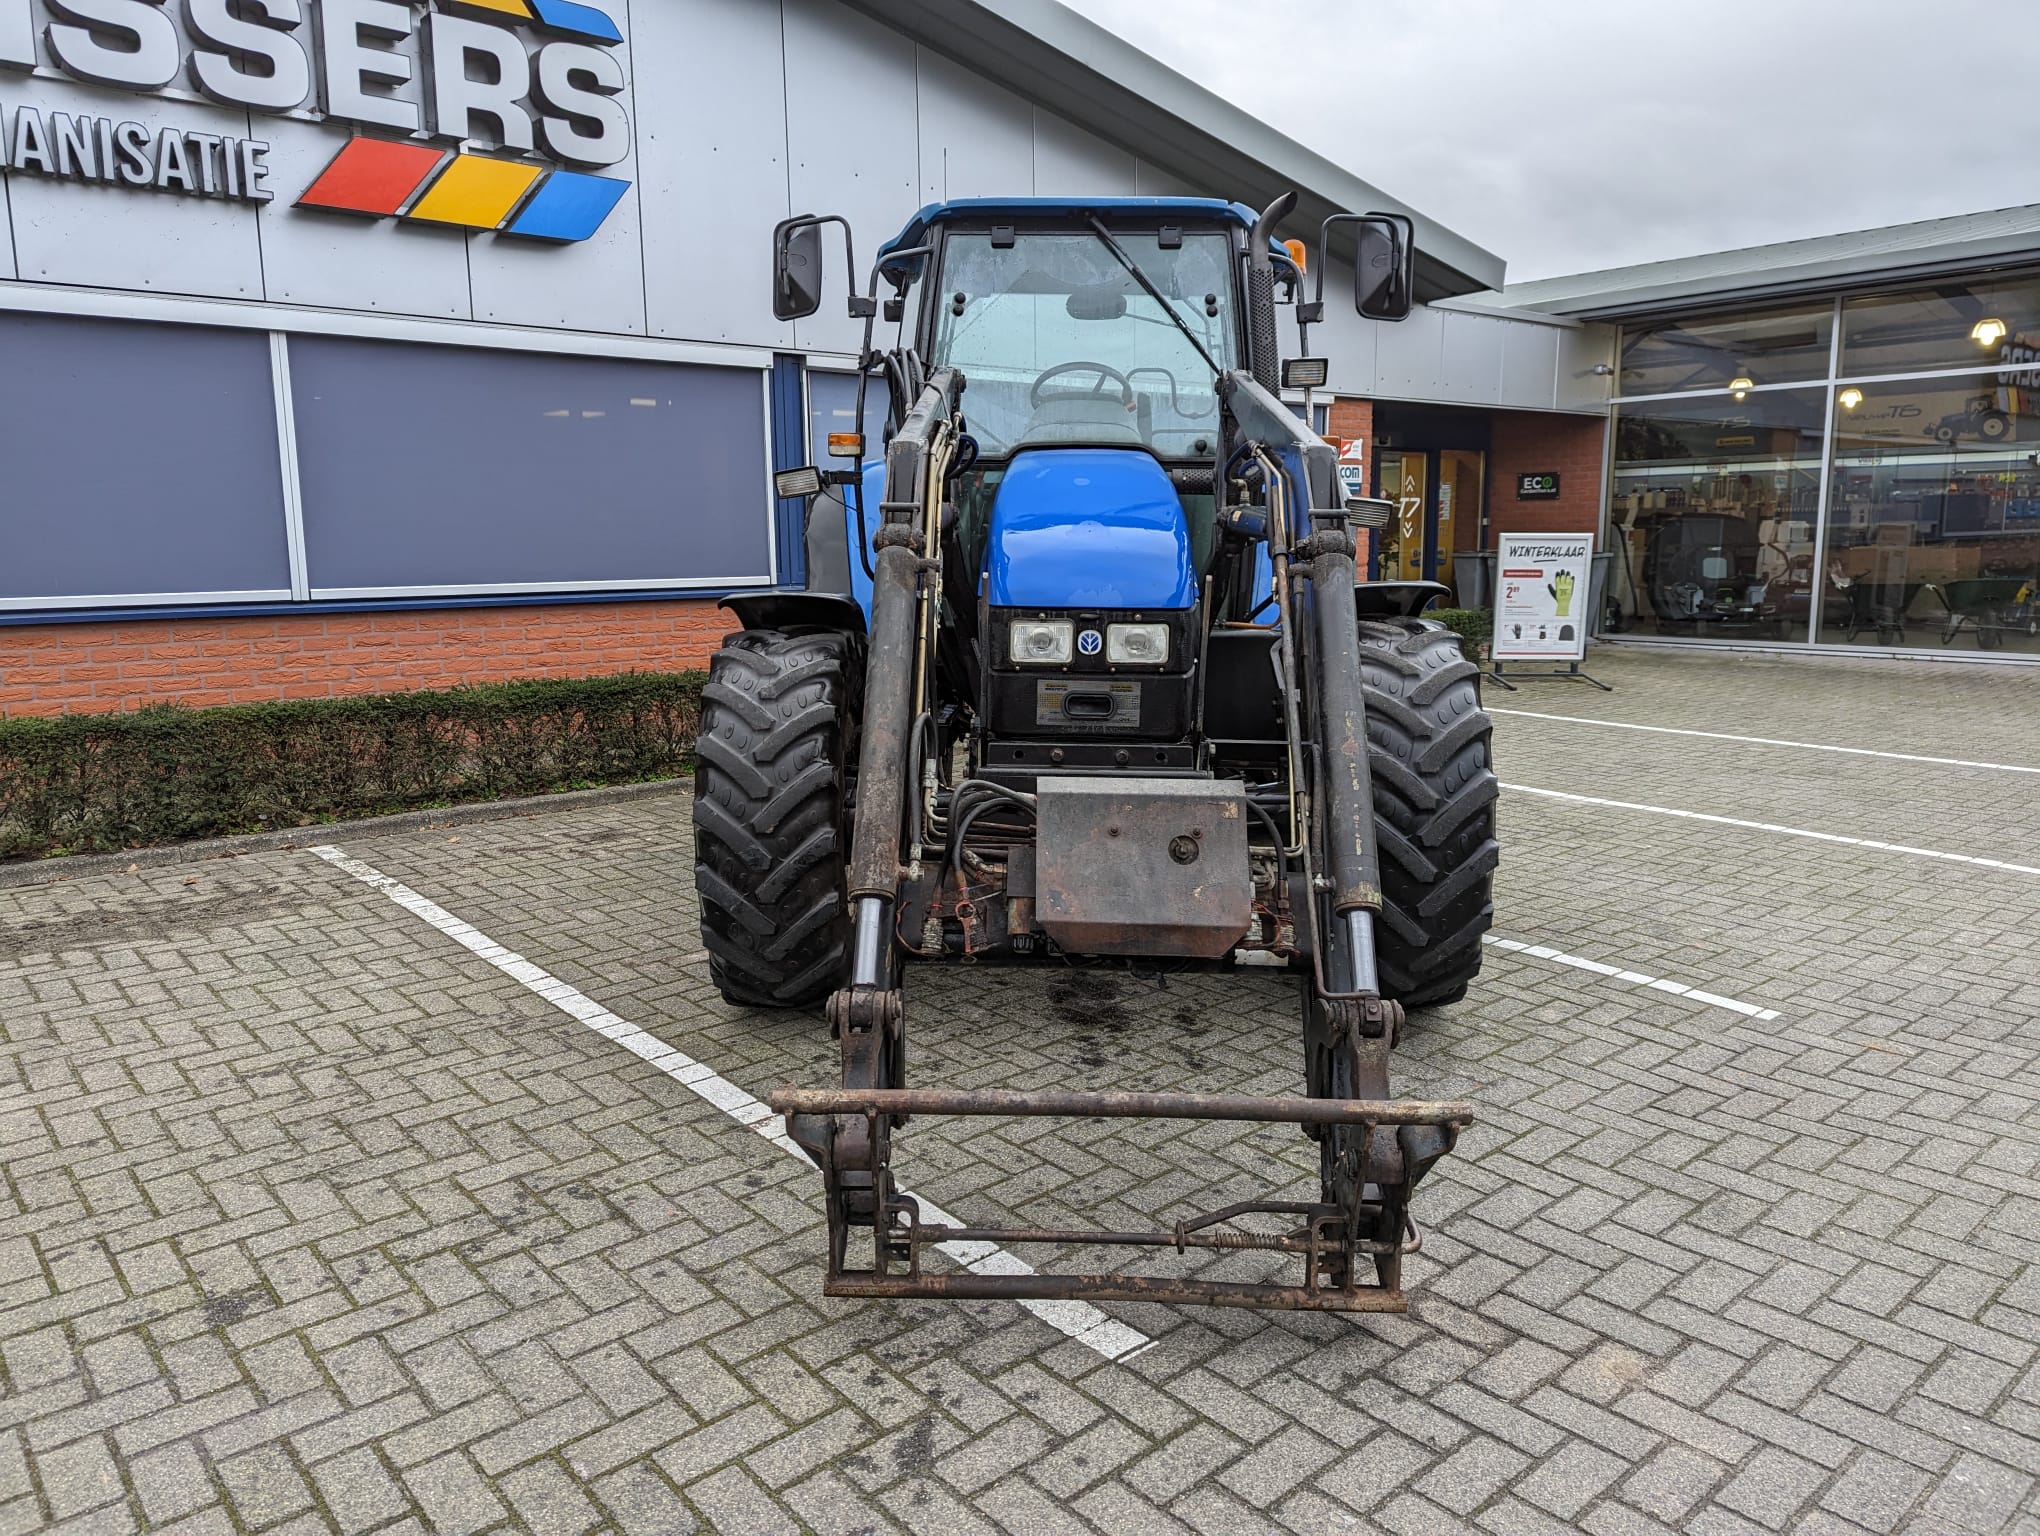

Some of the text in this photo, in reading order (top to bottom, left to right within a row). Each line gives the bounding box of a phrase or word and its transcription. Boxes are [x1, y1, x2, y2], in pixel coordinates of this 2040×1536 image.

[0, 102, 274, 204] ANISATIE
[1888, 404, 1922, 418] T6
[1523, 476, 1553, 489] ECO
[1509, 545, 1586, 558] WINTERKLAAR
